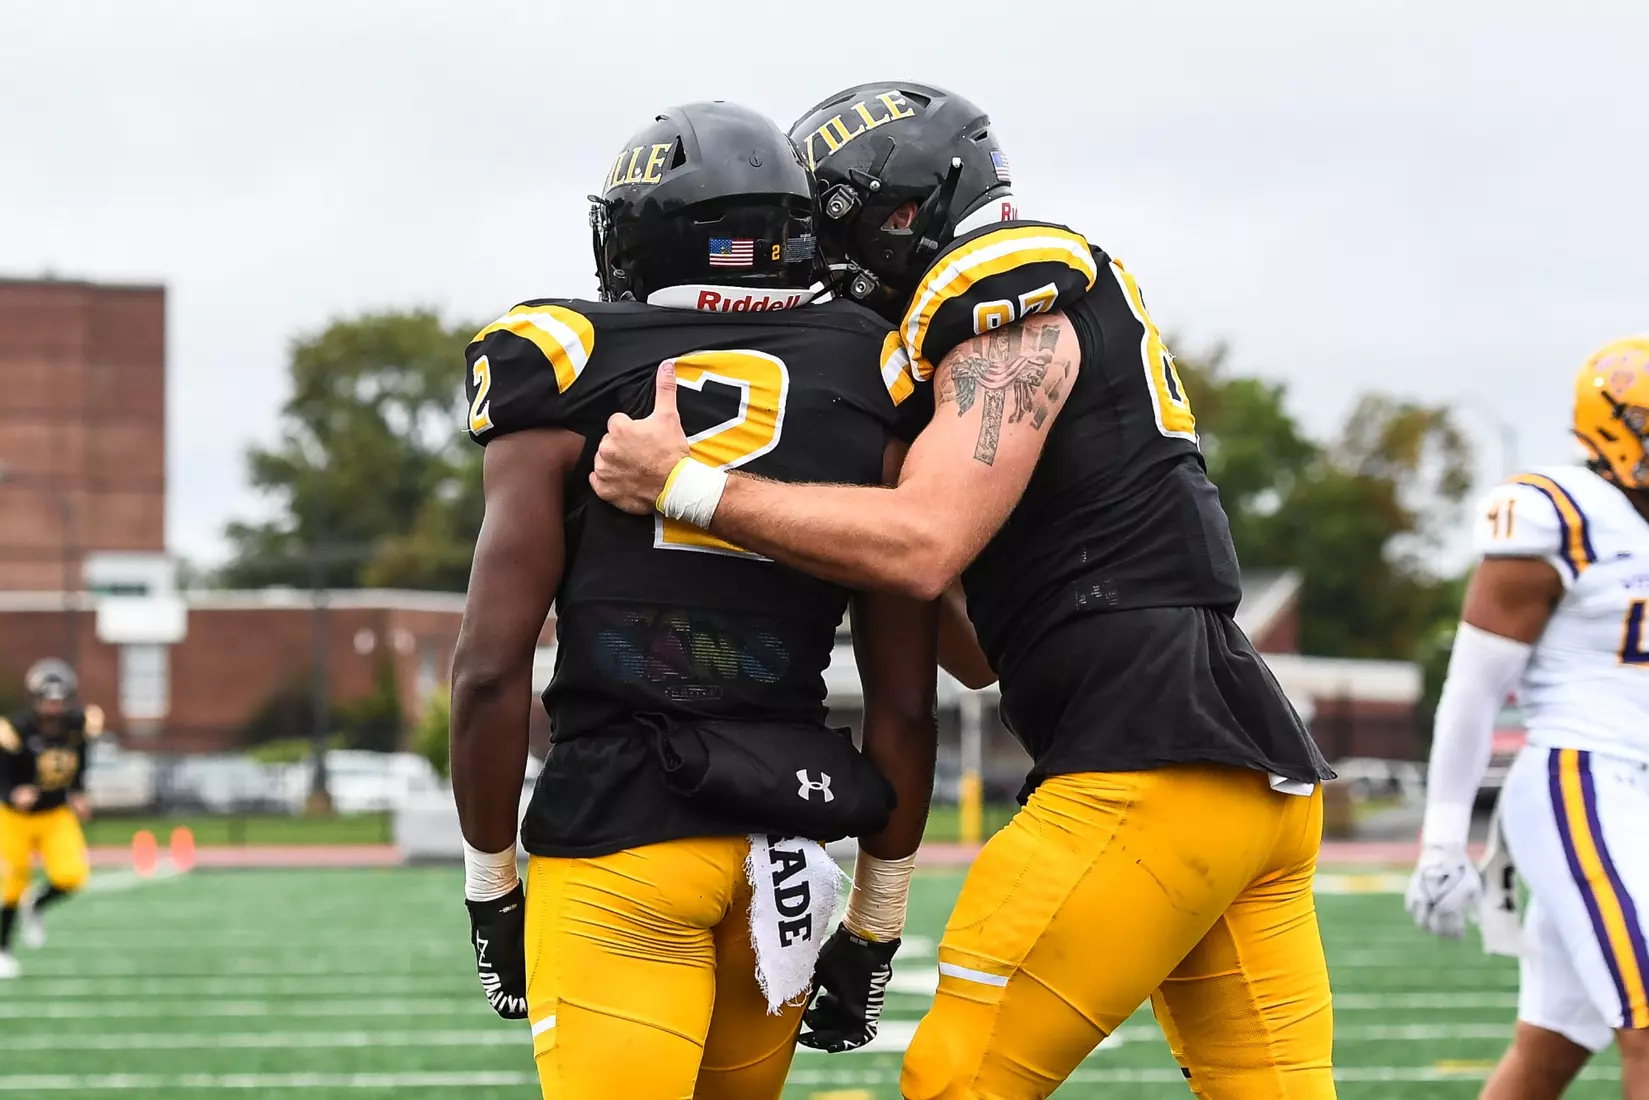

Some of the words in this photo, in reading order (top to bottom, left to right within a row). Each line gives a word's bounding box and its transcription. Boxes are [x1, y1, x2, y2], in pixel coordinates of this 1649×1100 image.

[771, 244, 780, 261] 2
[697, 290, 801, 312] Riddell
[470, 354, 495, 436] 2
[653, 349, 790, 562] 2
[767, 834, 812, 948] ADE
